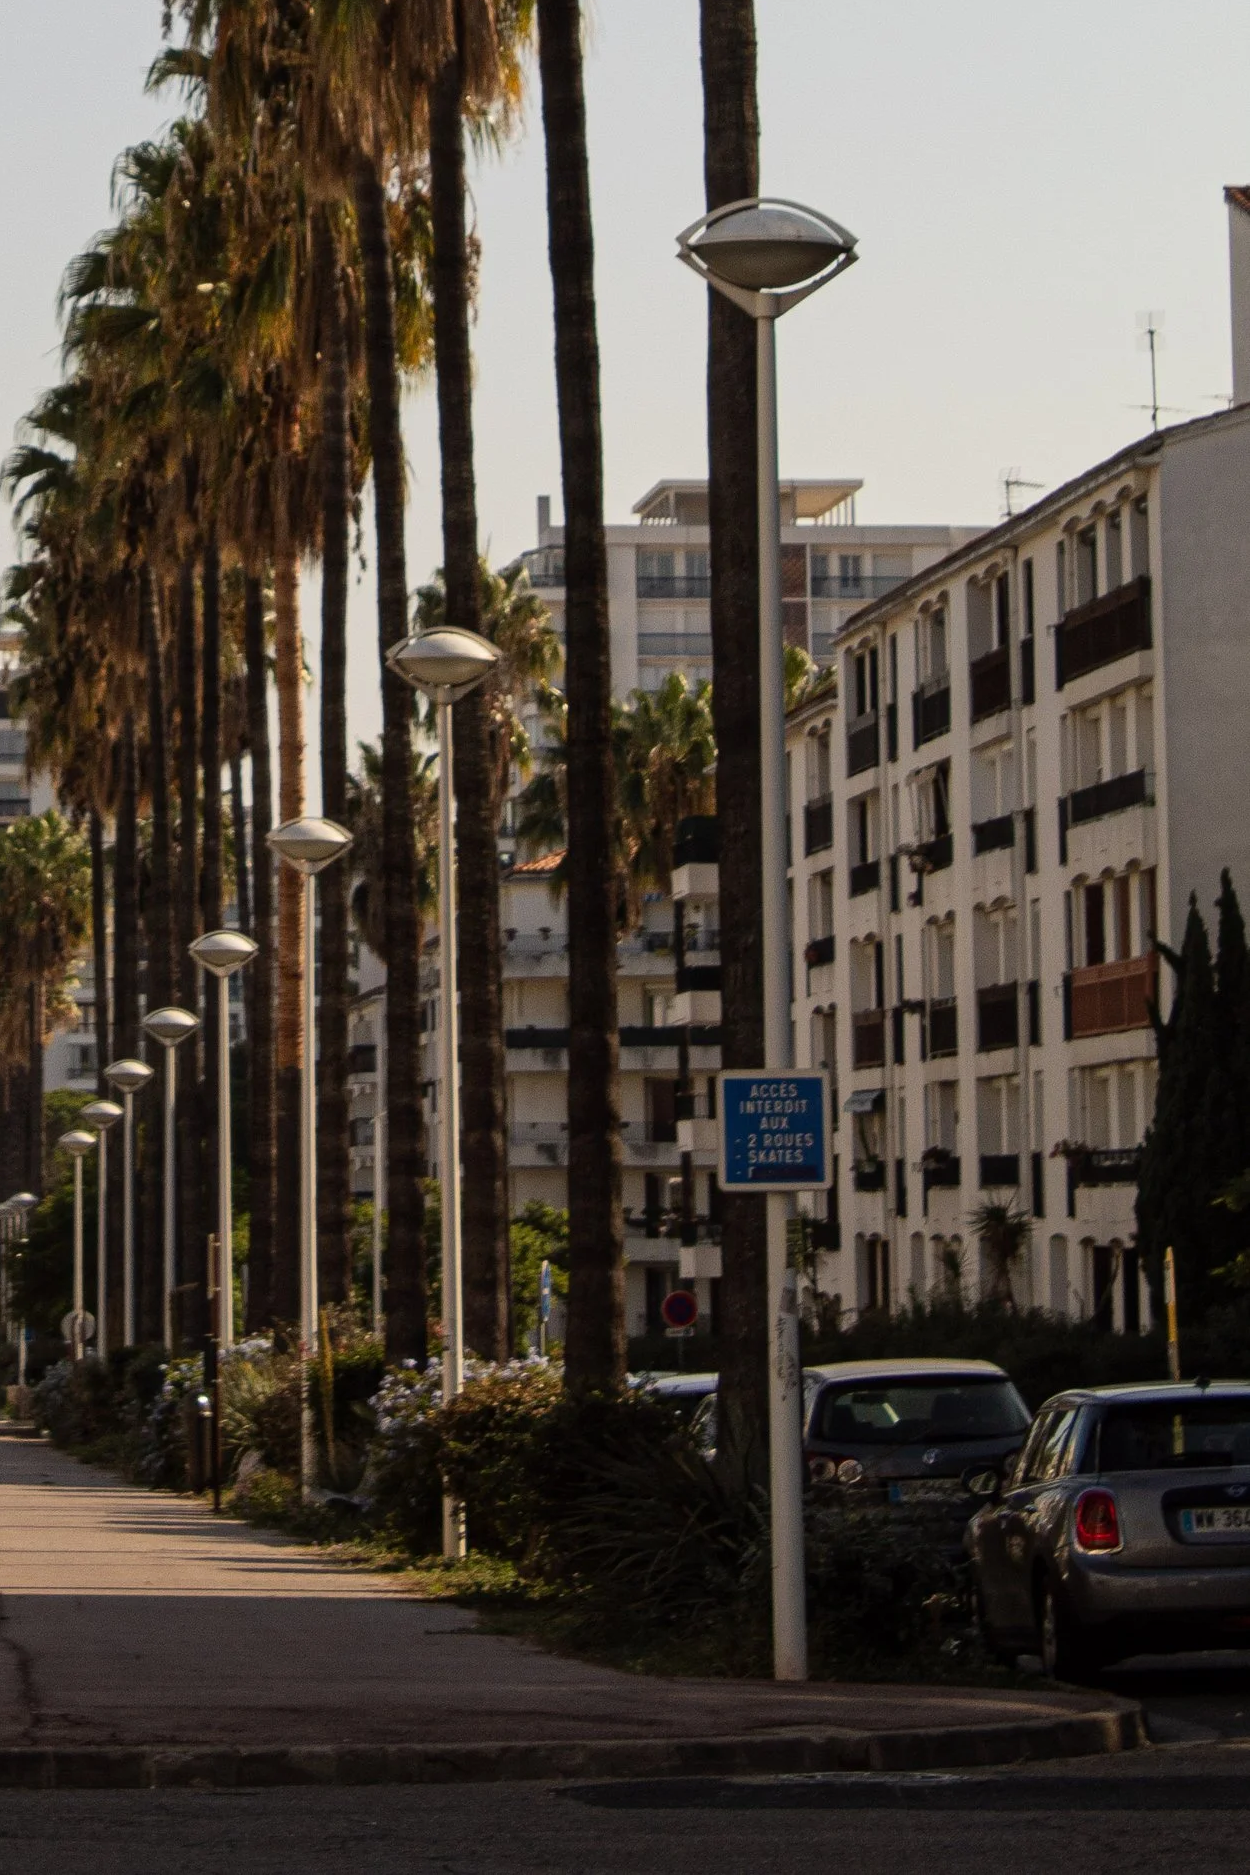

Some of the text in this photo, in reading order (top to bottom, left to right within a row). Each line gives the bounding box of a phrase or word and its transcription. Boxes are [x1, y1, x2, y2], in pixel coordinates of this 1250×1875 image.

[739, 1099, 808, 1114] INTERDIT
[760, 1116, 789, 1130] AUX
[747, 1132, 814, 1148] 2 ROUES
[748, 1149, 804, 1164] SKATES
